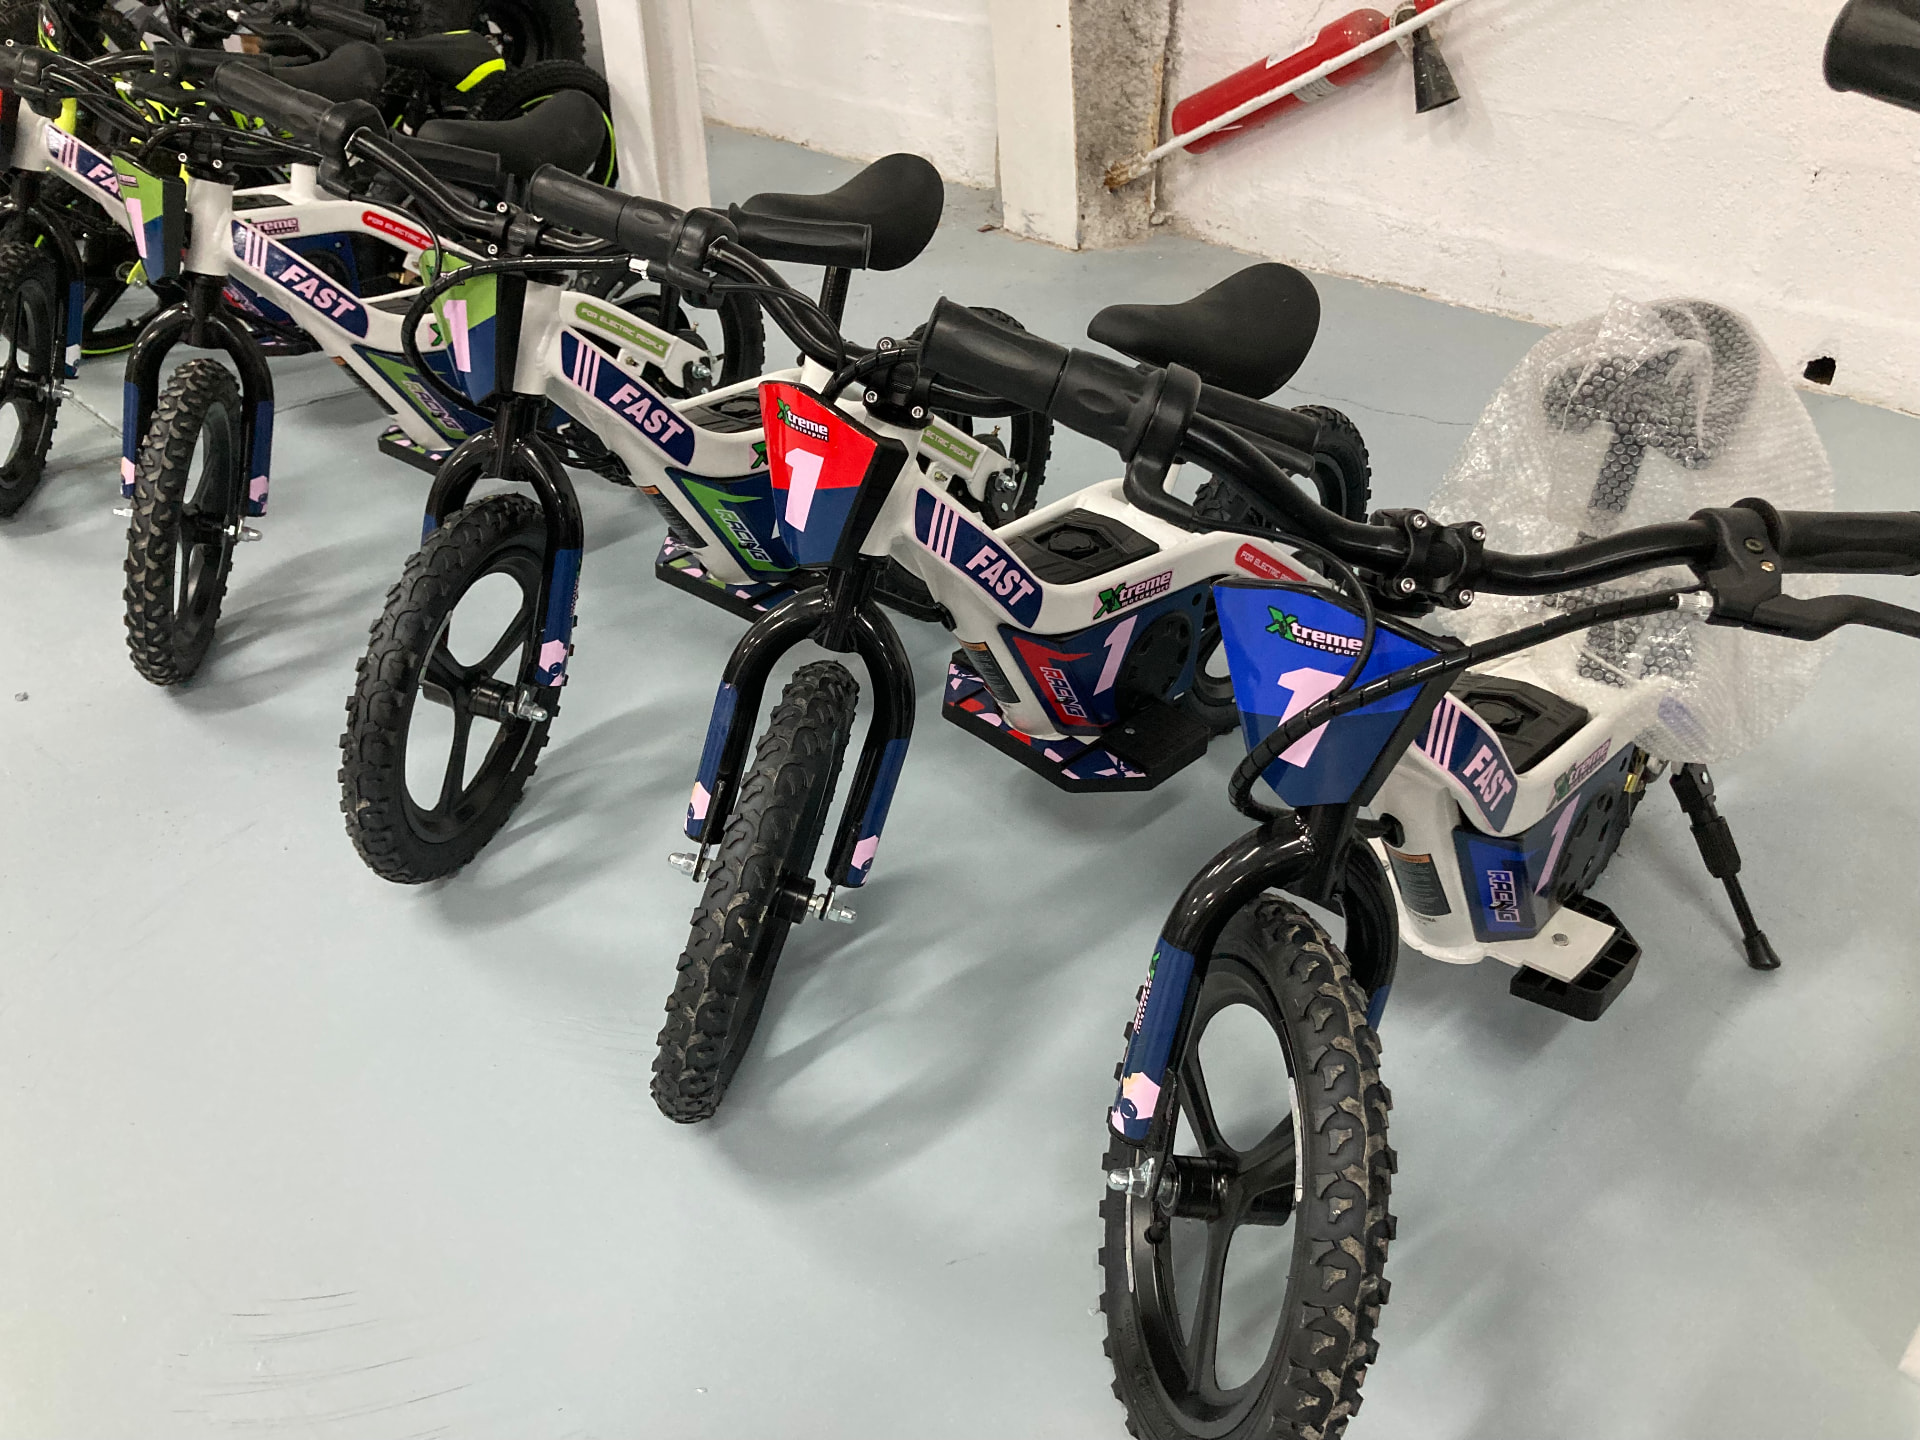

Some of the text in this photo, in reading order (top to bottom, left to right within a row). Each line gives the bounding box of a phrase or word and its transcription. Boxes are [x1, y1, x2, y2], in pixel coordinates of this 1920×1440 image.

[278, 263, 356, 319] FAST
[442, 299, 471, 373] 1
[608, 383, 685, 444] FAST
[776, 397, 829, 436] Xtreme
[784, 447, 825, 533] 1
[965, 544, 1036, 607] FAST
[1093, 570, 1172, 620] Xtreme
[1092, 614, 1138, 697] 1
[1265, 605, 1363, 651] Xtreme
[1277, 667, 1346, 769] 1
[1462, 744, 1513, 812] FAST
